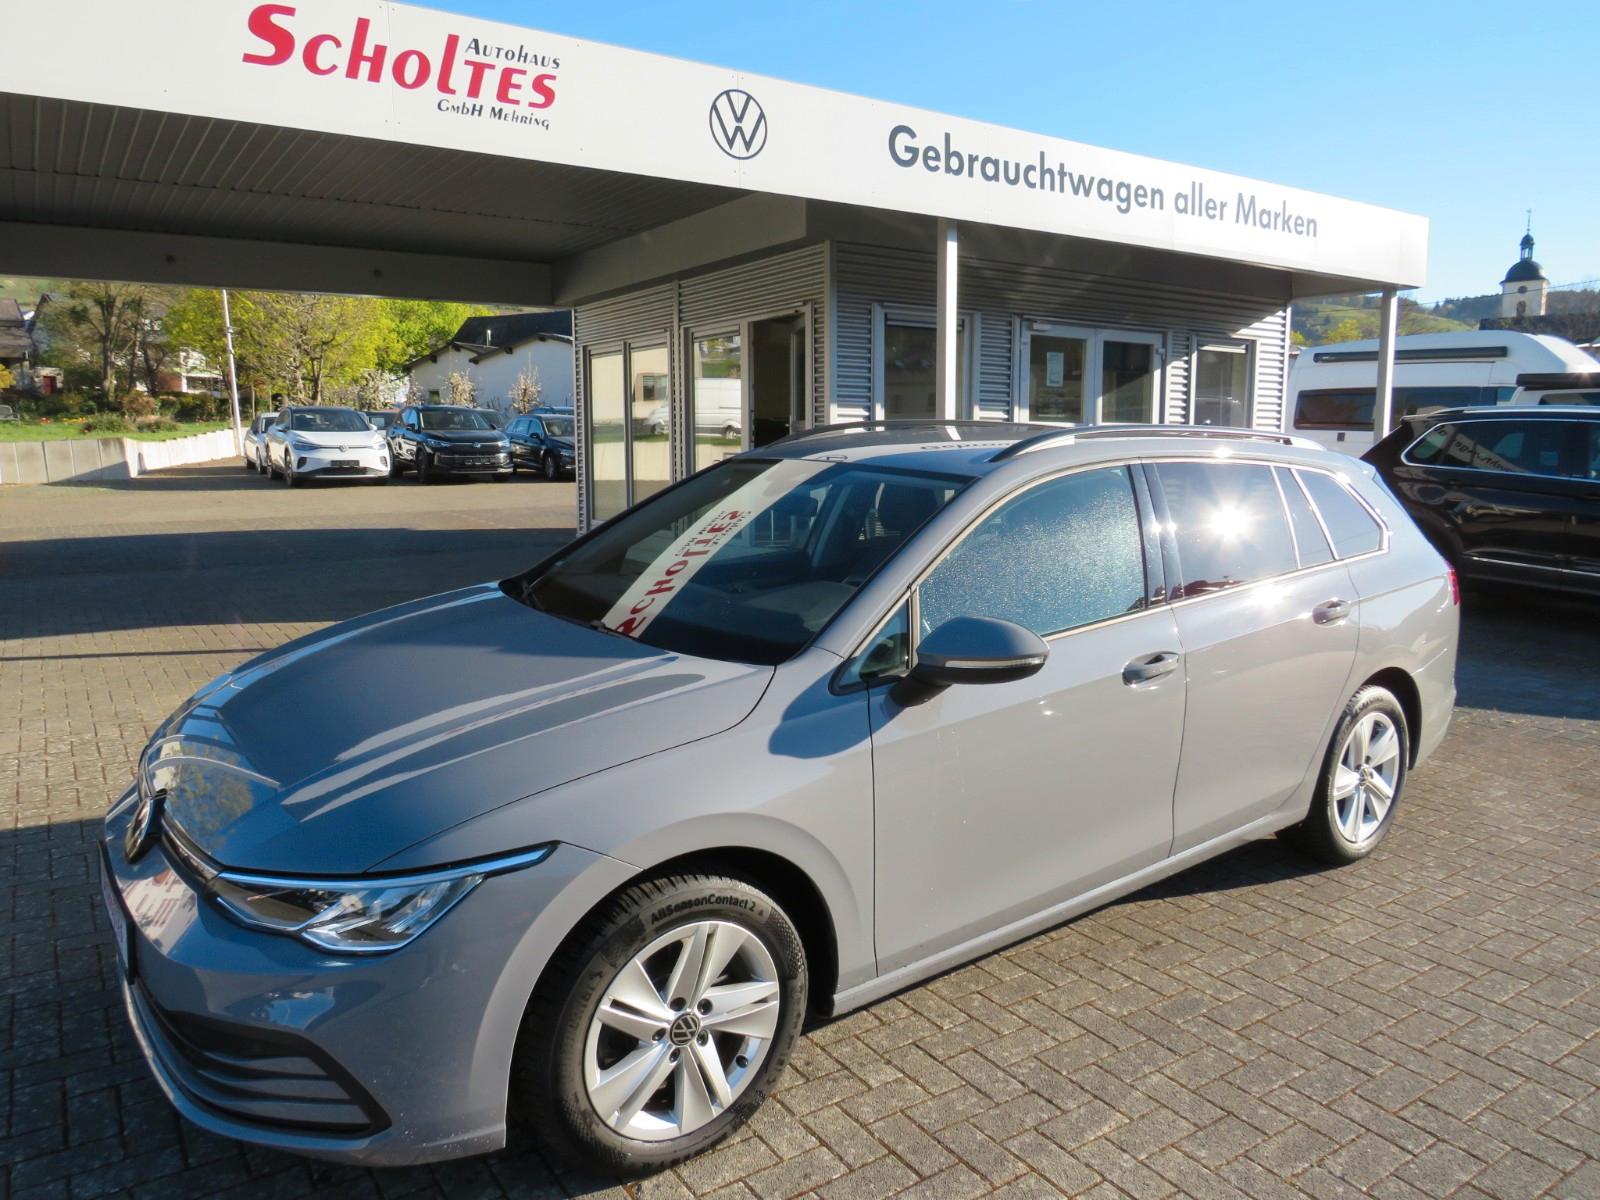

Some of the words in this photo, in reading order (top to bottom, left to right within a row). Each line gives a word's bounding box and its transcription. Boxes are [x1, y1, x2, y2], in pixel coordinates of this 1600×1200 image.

[888, 124, 1164, 214] Gebrauchtwagen
[1174, 181, 1228, 222] aller
[1235, 192, 1318, 238] Marken
[748, 901, 756, 912] 2
